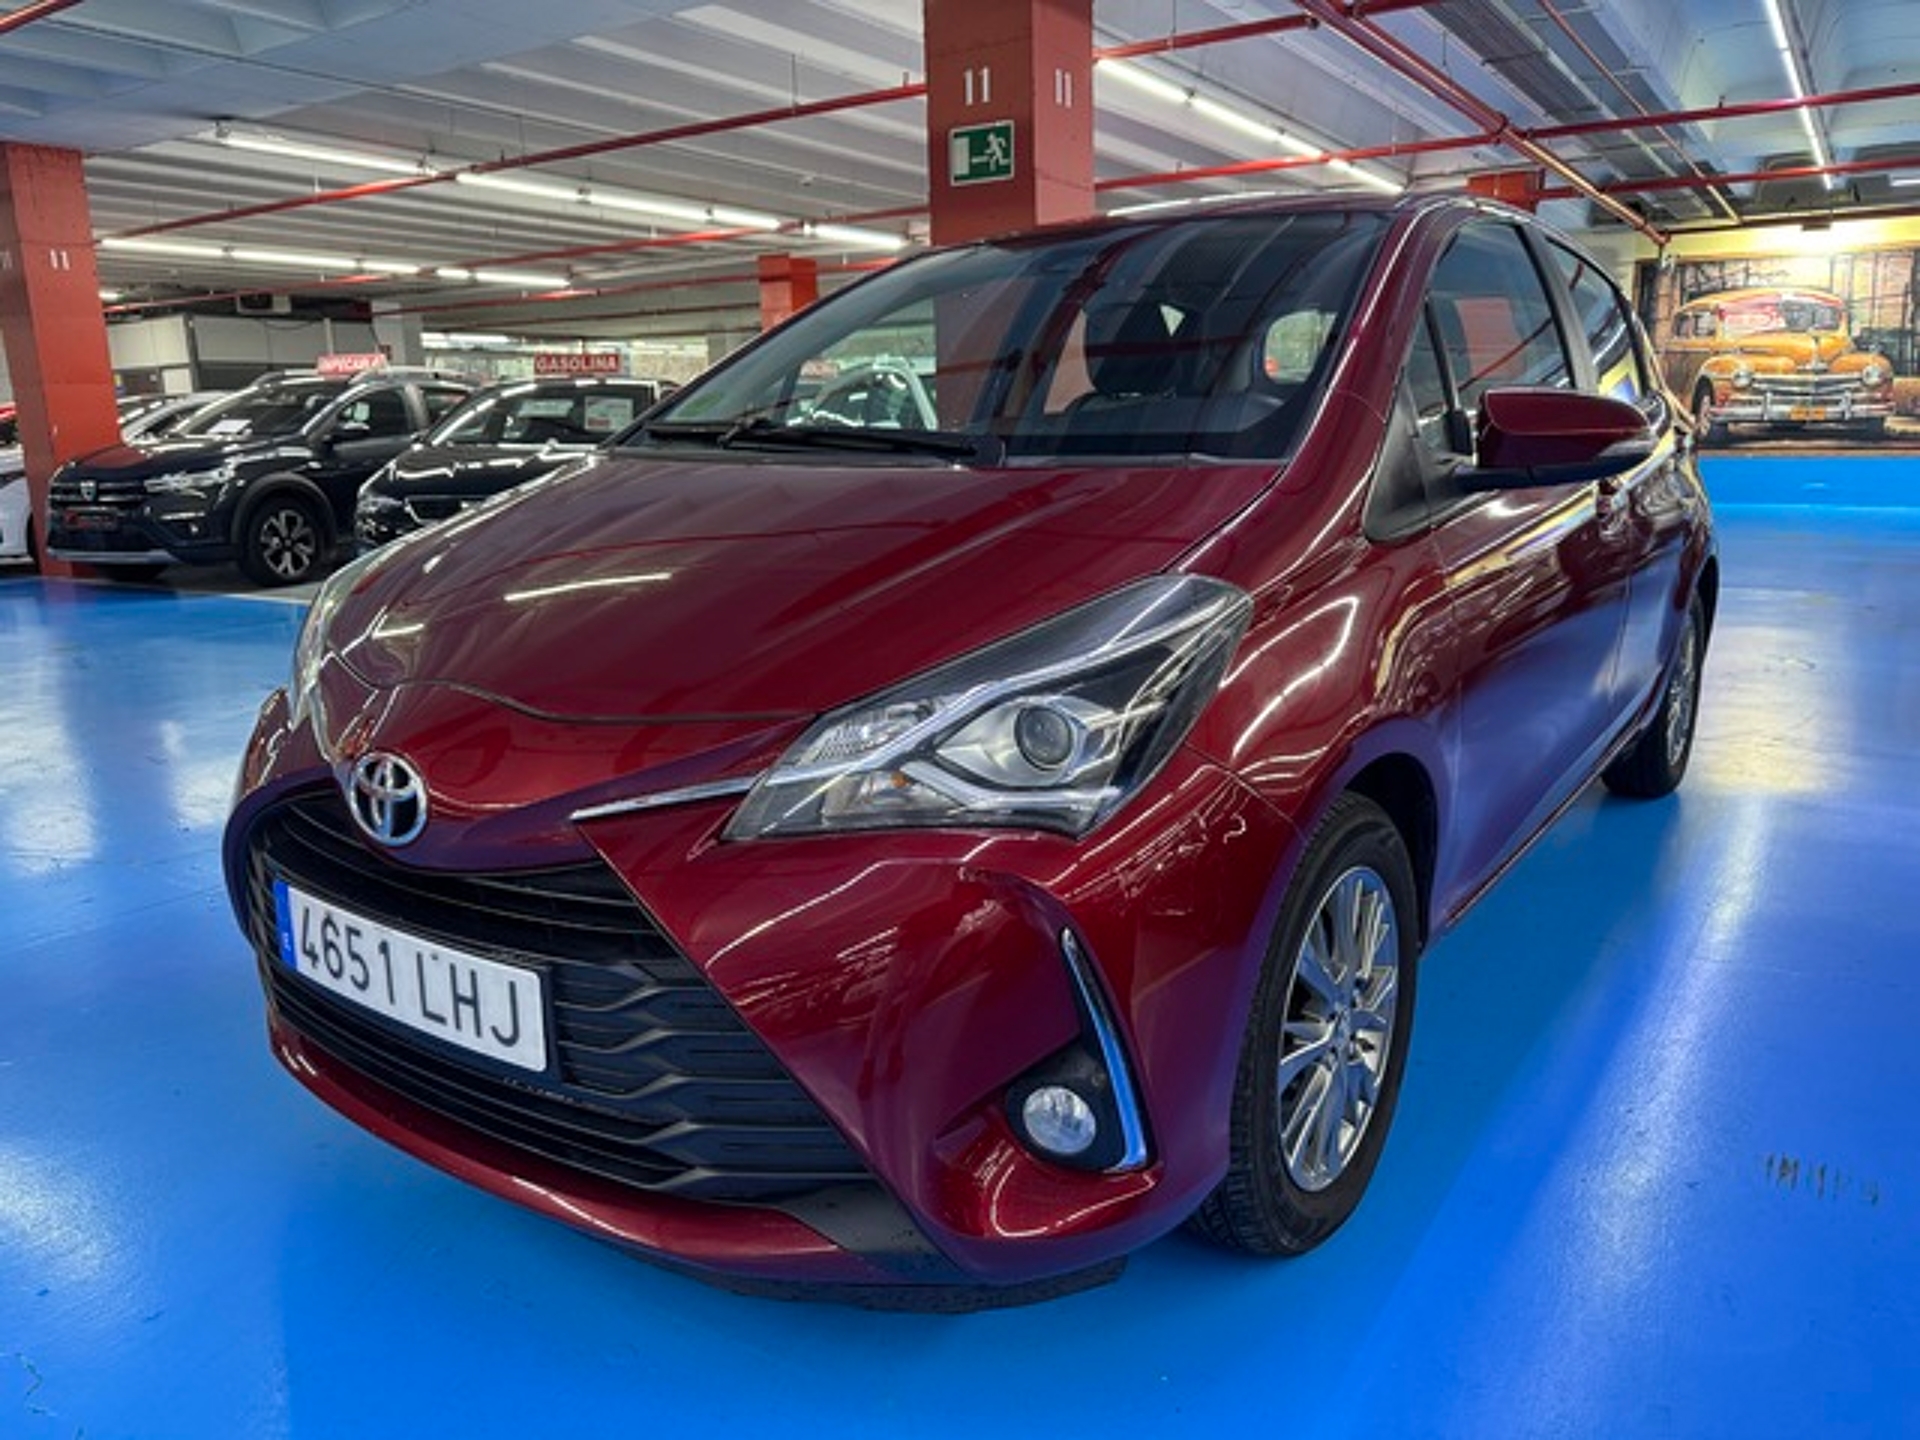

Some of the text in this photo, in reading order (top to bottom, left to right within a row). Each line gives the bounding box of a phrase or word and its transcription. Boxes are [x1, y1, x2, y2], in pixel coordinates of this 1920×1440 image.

[535, 355, 618, 372] GASOLINA
[301, 907, 520, 1048] 4651 LHJ
